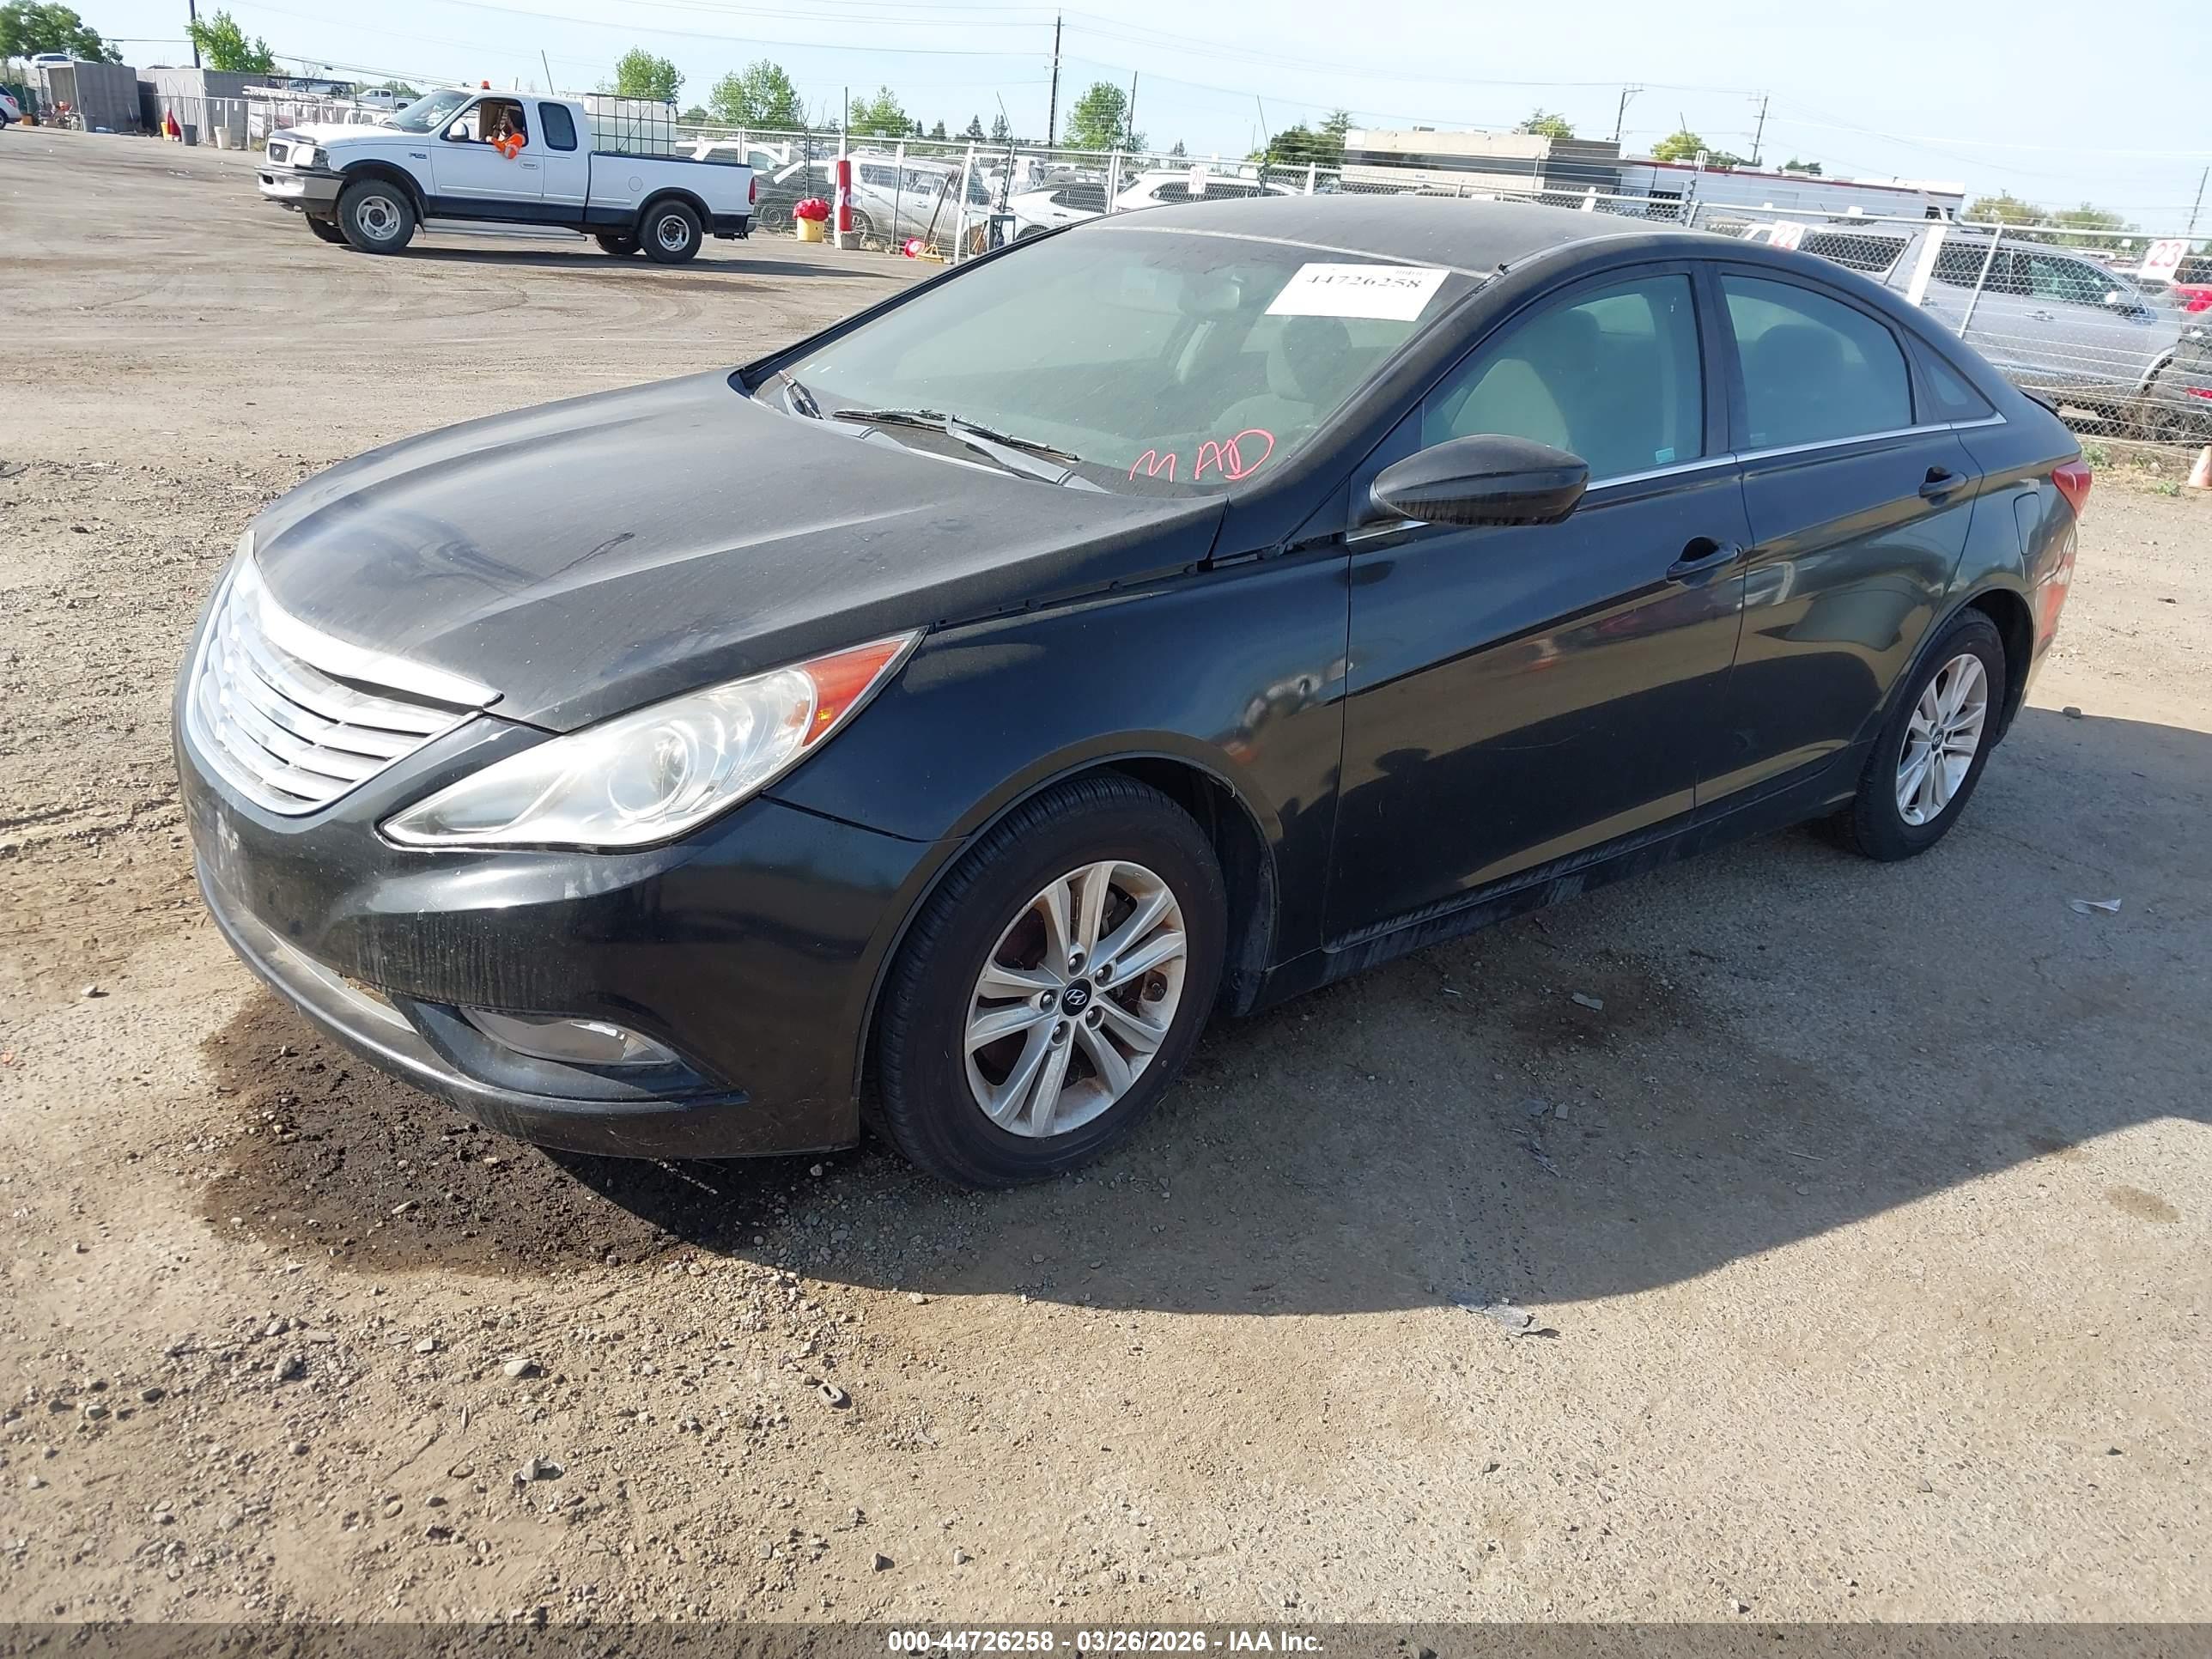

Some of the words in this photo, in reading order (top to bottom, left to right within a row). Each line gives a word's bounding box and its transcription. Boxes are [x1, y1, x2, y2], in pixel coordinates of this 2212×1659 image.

[1192, 170, 1205, 186] 20
[1773, 224, 1800, 248] 22
[2148, 242, 2182, 267] 23
[1306, 275, 1422, 289] 44726258
